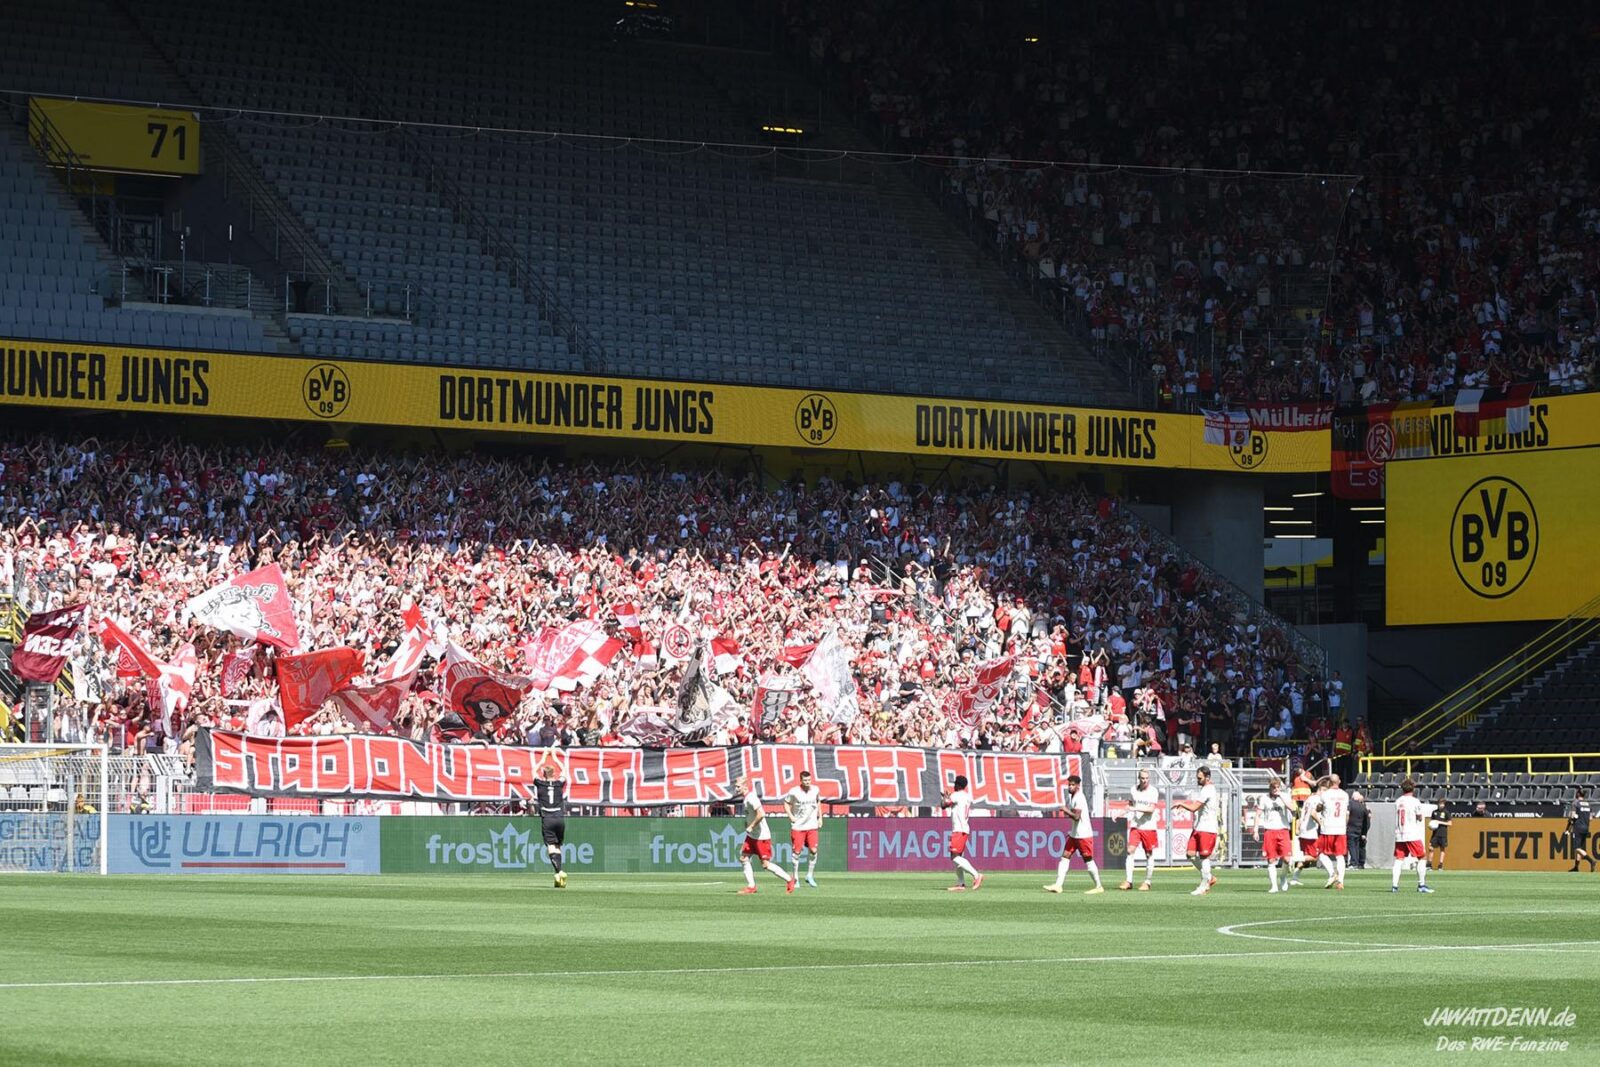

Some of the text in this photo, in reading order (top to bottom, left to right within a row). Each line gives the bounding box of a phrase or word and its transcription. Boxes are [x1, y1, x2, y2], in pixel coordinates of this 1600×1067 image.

[147, 123, 186, 161] 71
[117, 356, 209, 406] JUNGS
[309, 369, 346, 401] BVB
[319, 402, 333, 413] 09
[439, 375, 713, 434] DORTMUNDER JUNGS
[801, 398, 833, 429] BVB
[916, 404, 1156, 460] DORTMUNDER JUNGS
[1463, 487, 1530, 563] BVB
[1481, 561, 1507, 587] 09
[1334, 801, 1341, 818] 3
[852, 830, 872, 858] T
[1015, 830, 1099, 858] SPO
[1472, 831, 1543, 860] JETZT
